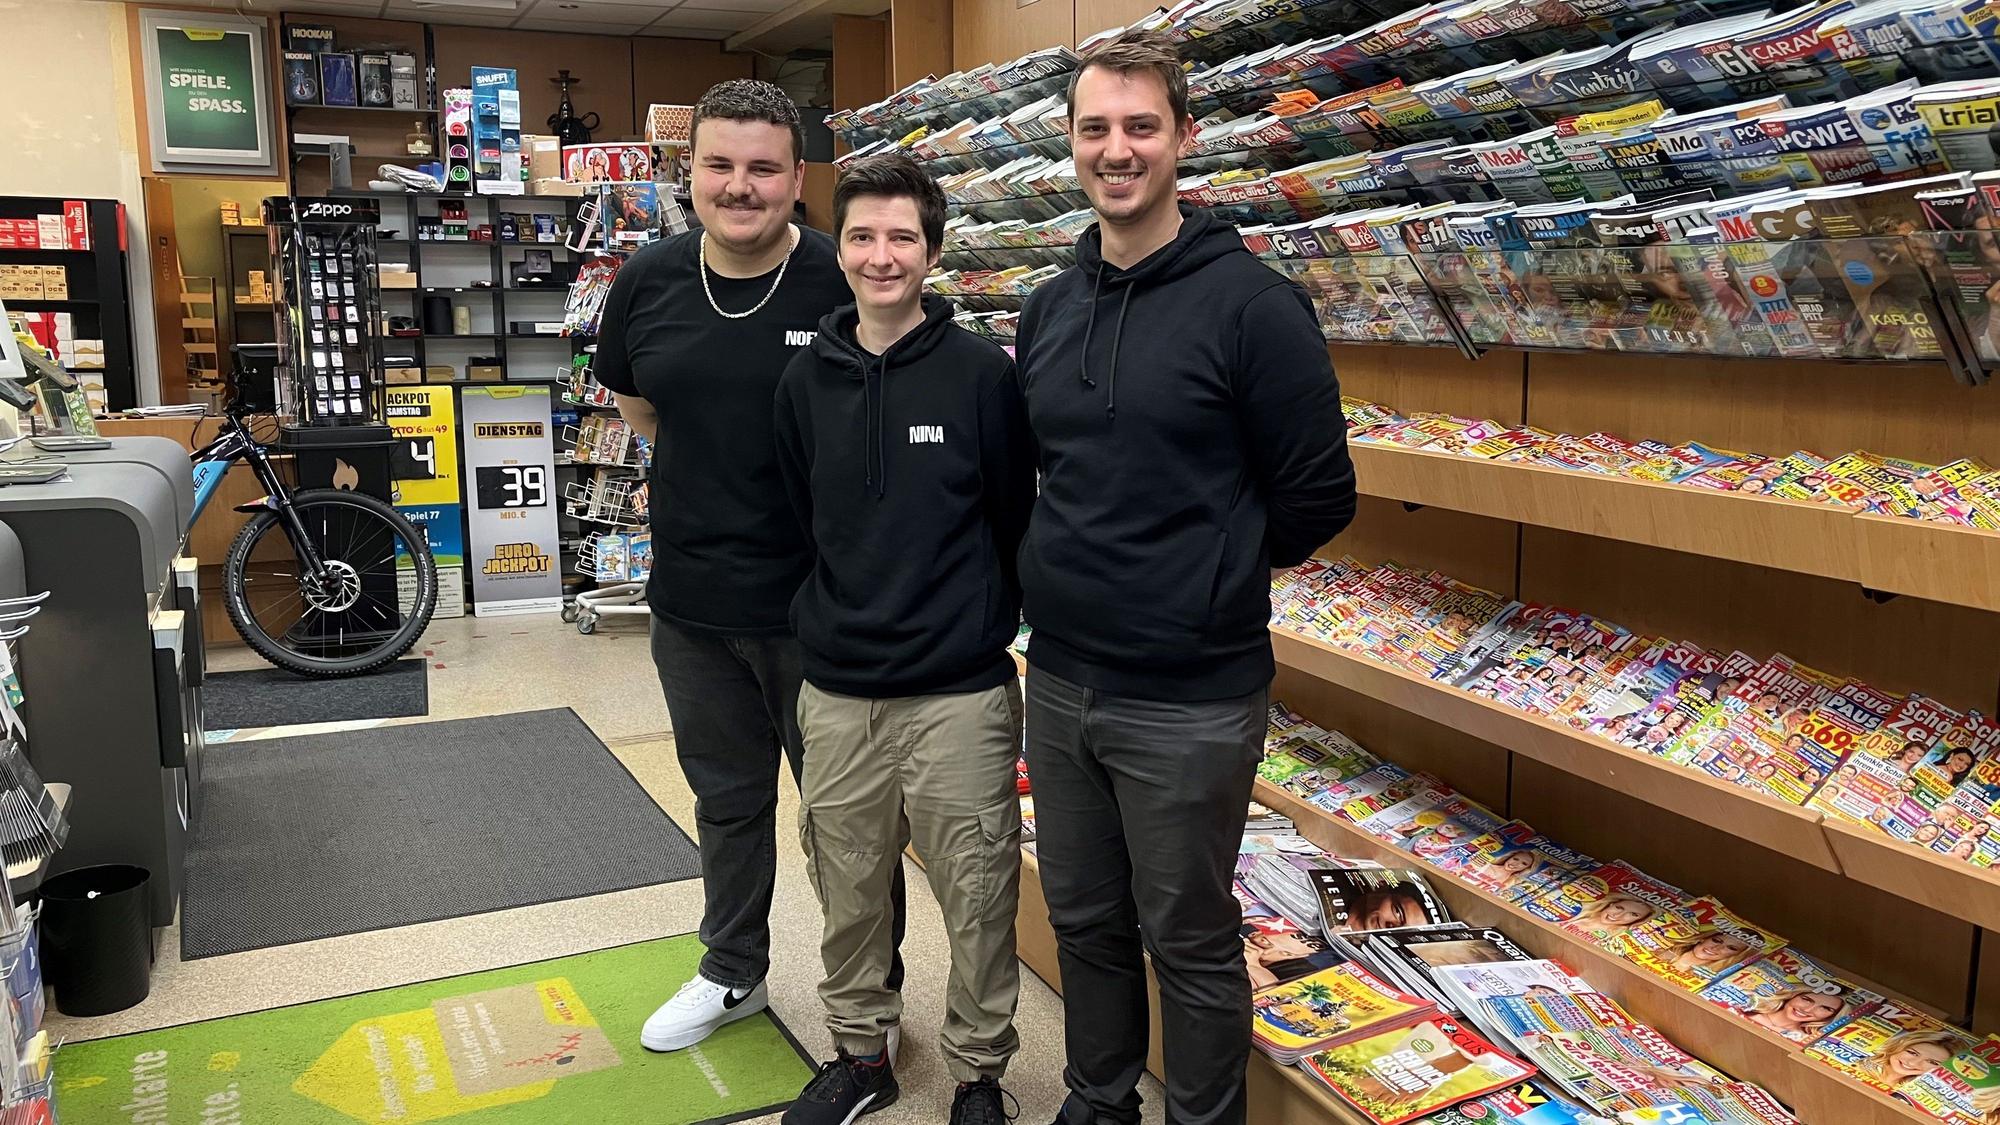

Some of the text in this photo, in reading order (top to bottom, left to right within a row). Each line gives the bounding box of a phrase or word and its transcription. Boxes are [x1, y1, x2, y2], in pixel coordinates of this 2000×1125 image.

[292, 28, 334, 40] HOOKAH
[285, 52, 312, 60] HOOKAH
[169, 73, 231, 90] SPIELE.
[188, 98, 247, 113] SPASS.
[1469, 88, 1513, 107] CAMPI
[1596, 111, 1650, 127] wir müssen reden!
[1482, 147, 1529, 168] Mak
[1606, 141, 1662, 159] LINUX
[1624, 152, 1660, 168] WELT
[1626, 177, 1673, 193] Linux
[73, 207, 84, 233] Winston
[1524, 218, 1556, 231] DVD
[1599, 222, 1660, 238] Esqu
[1799, 304, 1824, 313] BRAD
[1803, 312, 1824, 322] PITT
[785, 330, 818, 346] NOF
[387, 392, 431, 405] ACKPOT
[387, 406, 421, 416] SAMSTAG
[389, 426, 414, 434] OTTO
[416, 425, 423, 434] 6
[435, 425, 448, 433] 49
[477, 425, 543, 437] DIENSTAG
[909, 425, 944, 444] NINA
[410, 440, 435, 476] 4
[501, 466, 546, 506] 39
[405, 510, 441, 521] Spiel 77
[500, 511, 520, 519] MIO.
[495, 542, 533, 558] EURO
[482, 555, 548, 575] JACKPOT
[416, 552, 429, 618] SCHWALBE
[1840, 684, 1893, 715] neue
[1827, 696, 1880, 729] PAUS
[1902, 700, 1955, 735] Schö
[1888, 713, 1937, 748] Zei
[1965, 716, 2000, 743] Sch
[1852, 758, 1874, 775] ihrem
[1857, 751, 1885, 769] Dunkle
[1541, 963, 1583, 994] GESU
[1797, 964, 1842, 997] top
[1634, 1023, 1688, 1062] FUNK
[1371, 1053, 1433, 1095] GESUND!
[1930, 1066, 1976, 1100] NEU!
[1939, 1084, 1957, 1101] 80
